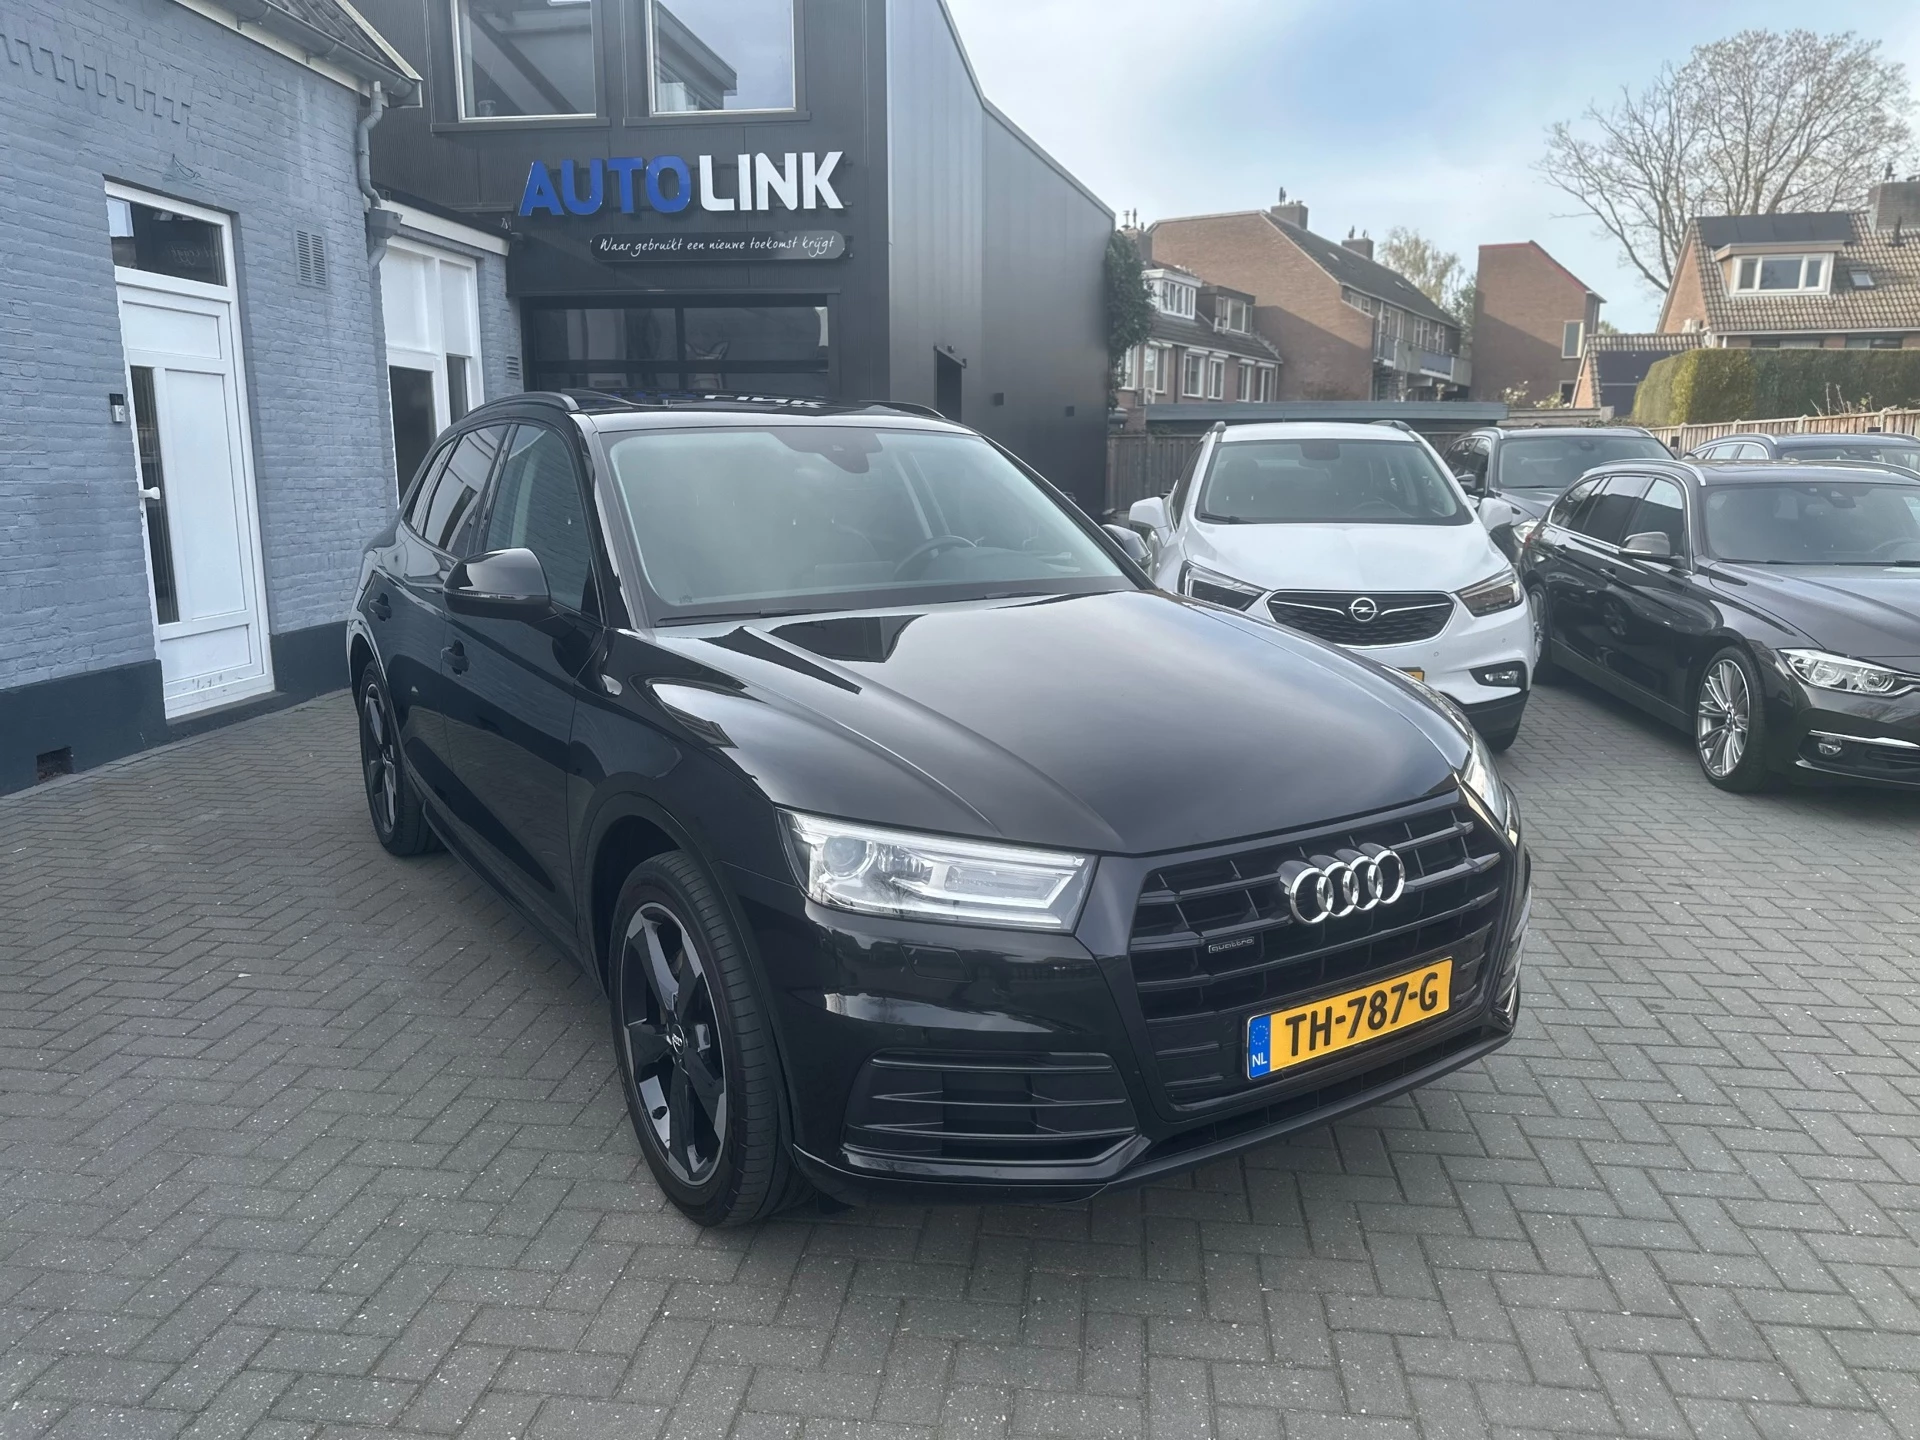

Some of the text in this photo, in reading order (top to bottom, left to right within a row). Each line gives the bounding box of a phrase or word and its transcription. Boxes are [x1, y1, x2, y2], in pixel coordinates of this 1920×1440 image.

[600, 236, 835, 257] Waar gebruikt een nieuwe toekomst krijgt
[1211, 938, 1253, 951] quattro
[1285, 972, 1439, 1057] TH-787-G
[1252, 1052, 1268, 1068] NL
